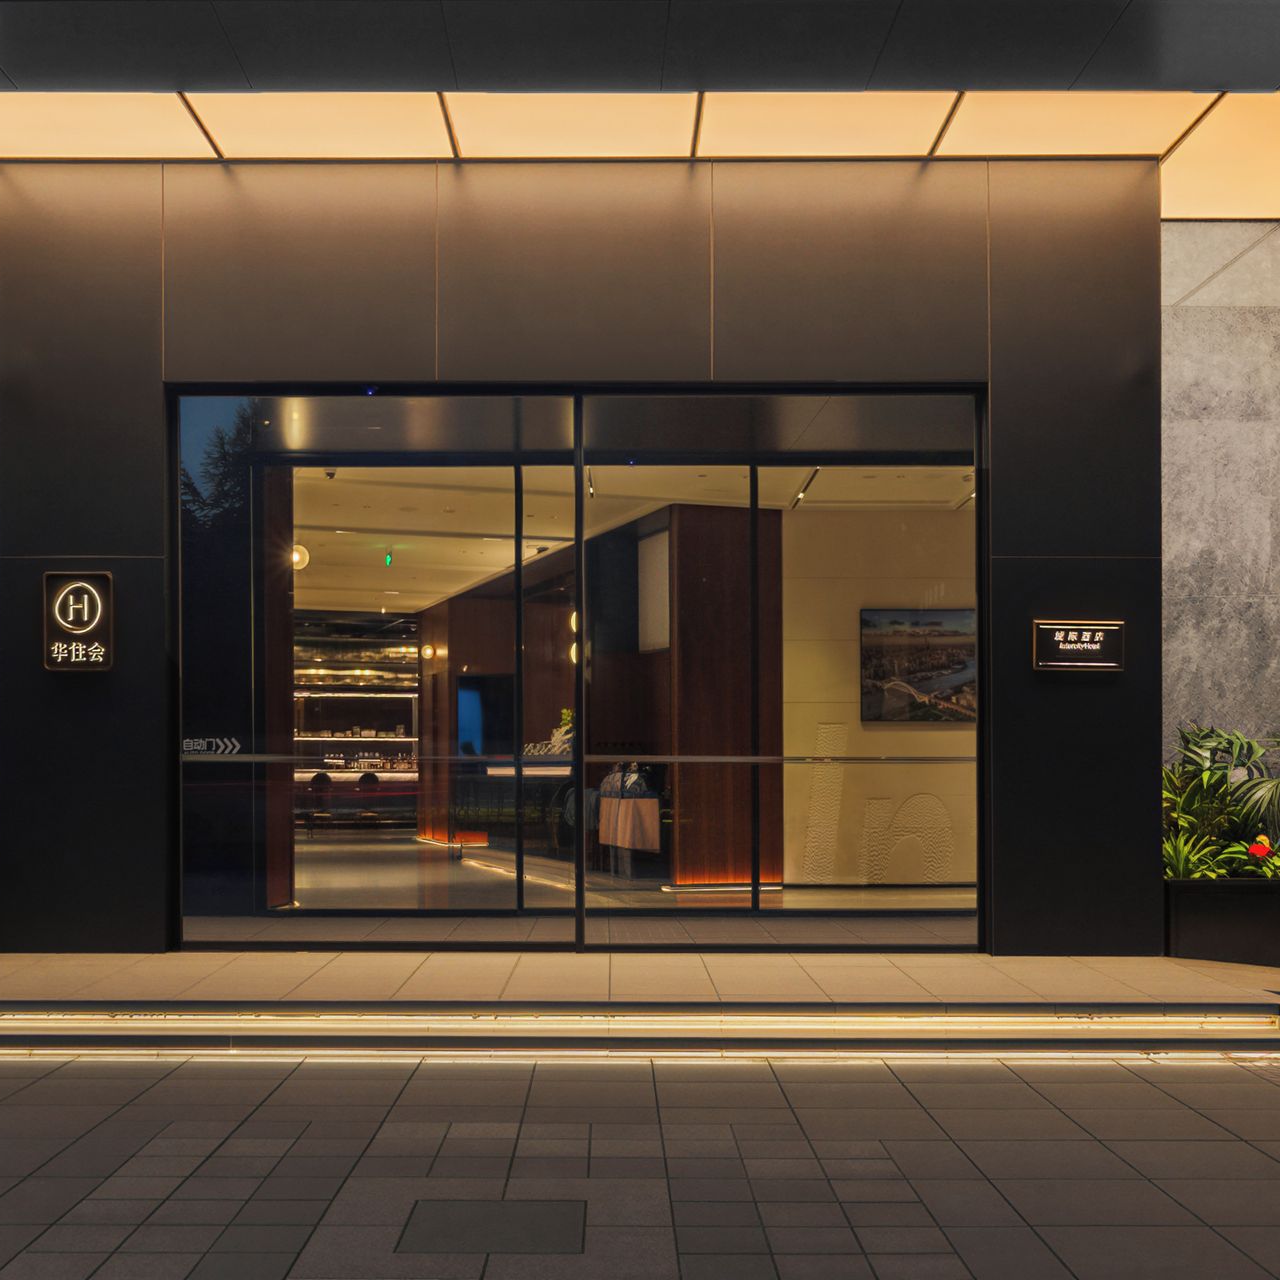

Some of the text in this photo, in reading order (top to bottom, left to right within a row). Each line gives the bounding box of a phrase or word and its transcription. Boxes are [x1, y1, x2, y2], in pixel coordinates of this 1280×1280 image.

[51, 641, 106, 663] 华住会
[183, 738, 216, 751] 自动门
